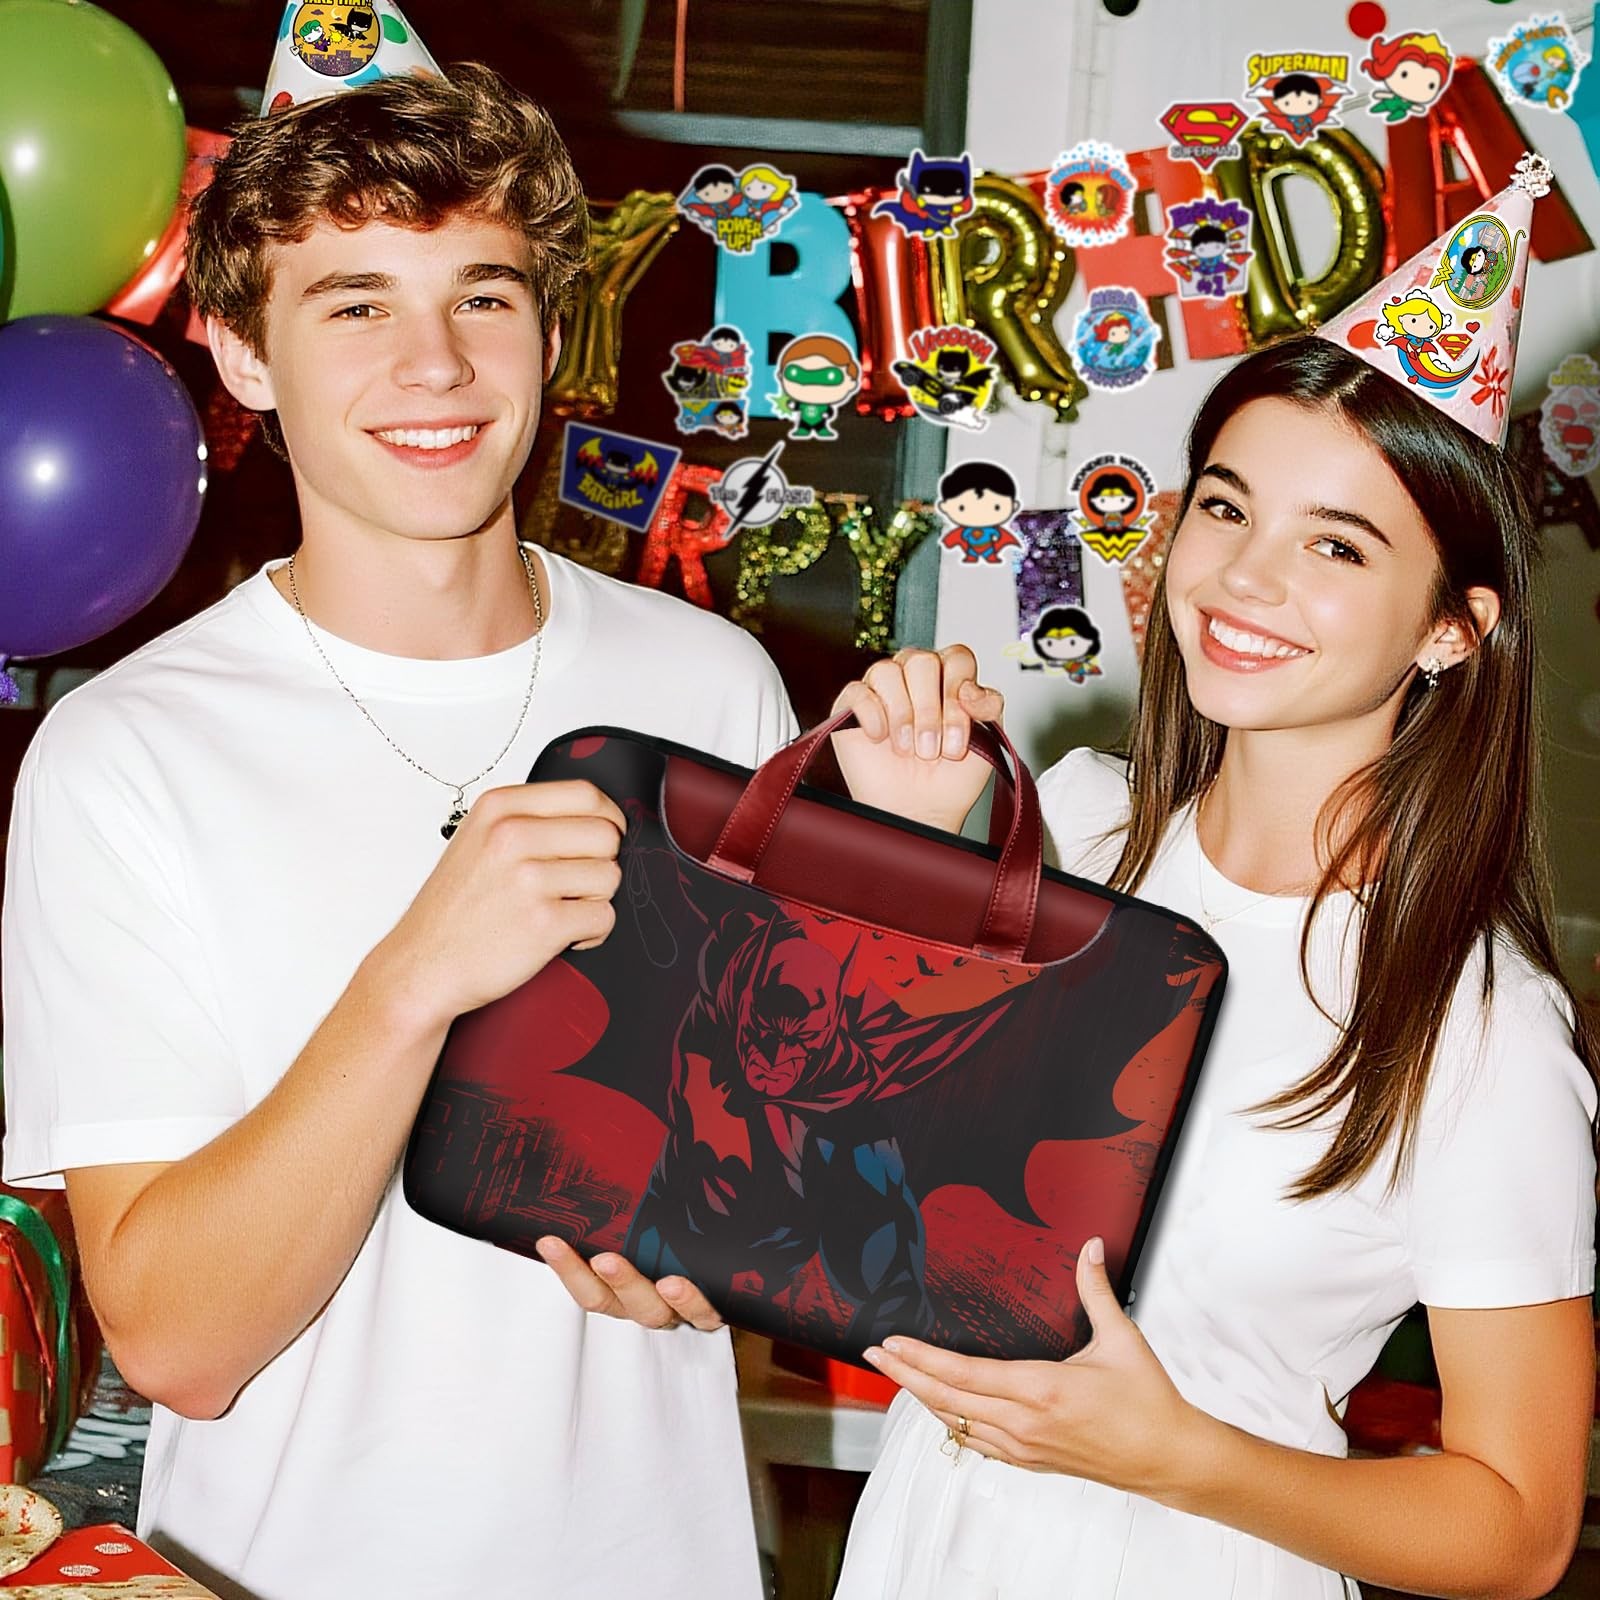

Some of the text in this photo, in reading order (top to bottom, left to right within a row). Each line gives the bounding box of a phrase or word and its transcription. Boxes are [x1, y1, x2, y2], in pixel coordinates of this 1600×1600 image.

[1249, 52, 1349, 87] SUPERMAN
[1170, 145, 1239, 158] SUPERMAN
[717, 218, 763, 240] POWER
[727, 234, 752, 252] UP!
[1071, 456, 1154, 494] WONDER WOMAN
[766, 488, 812, 503] FLASH
